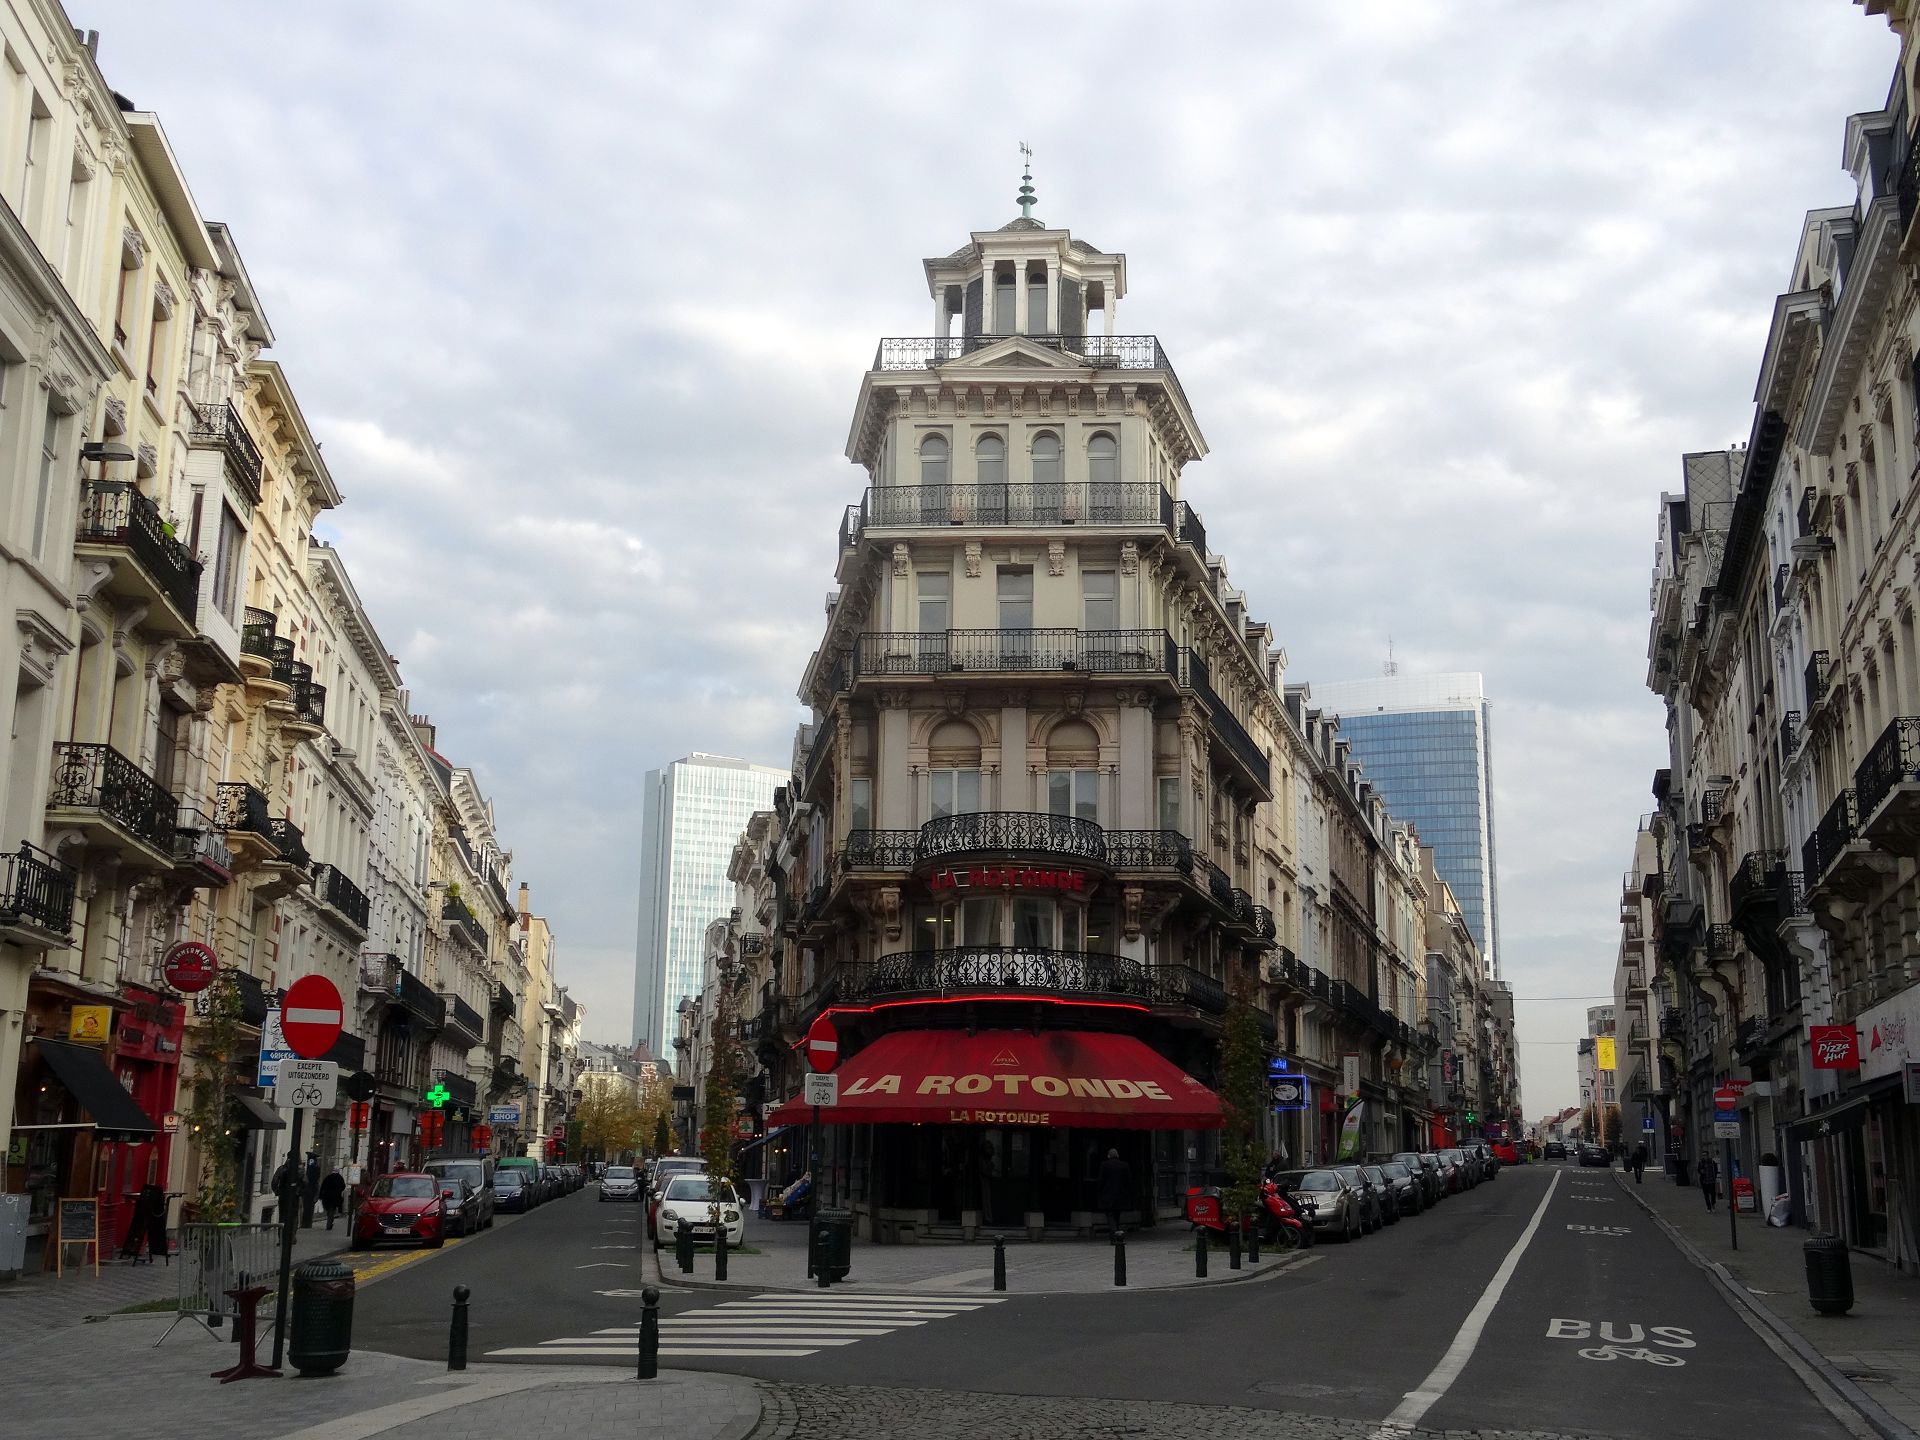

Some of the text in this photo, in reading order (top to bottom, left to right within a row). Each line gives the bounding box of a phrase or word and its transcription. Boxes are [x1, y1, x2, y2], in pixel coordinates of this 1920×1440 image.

[932, 869, 1085, 891] LA ROTONDE
[172, 947, 210, 963] TIMMERMANS
[1818, 1042, 1850, 1056] Pizza
[1824, 1051, 1849, 1063] Hut
[297, 1062, 322, 1071] EXCEPTE
[288, 1072, 329, 1081] UITGEZONDERD
[841, 1074, 1173, 1100] LA ROTONDE
[1726, 1082, 1743, 1093] lott
[950, 1110, 1049, 1124] LA ROTONDE
[1567, 1224, 1632, 1233] BUS
[1545, 1318, 1697, 1348] BUS
